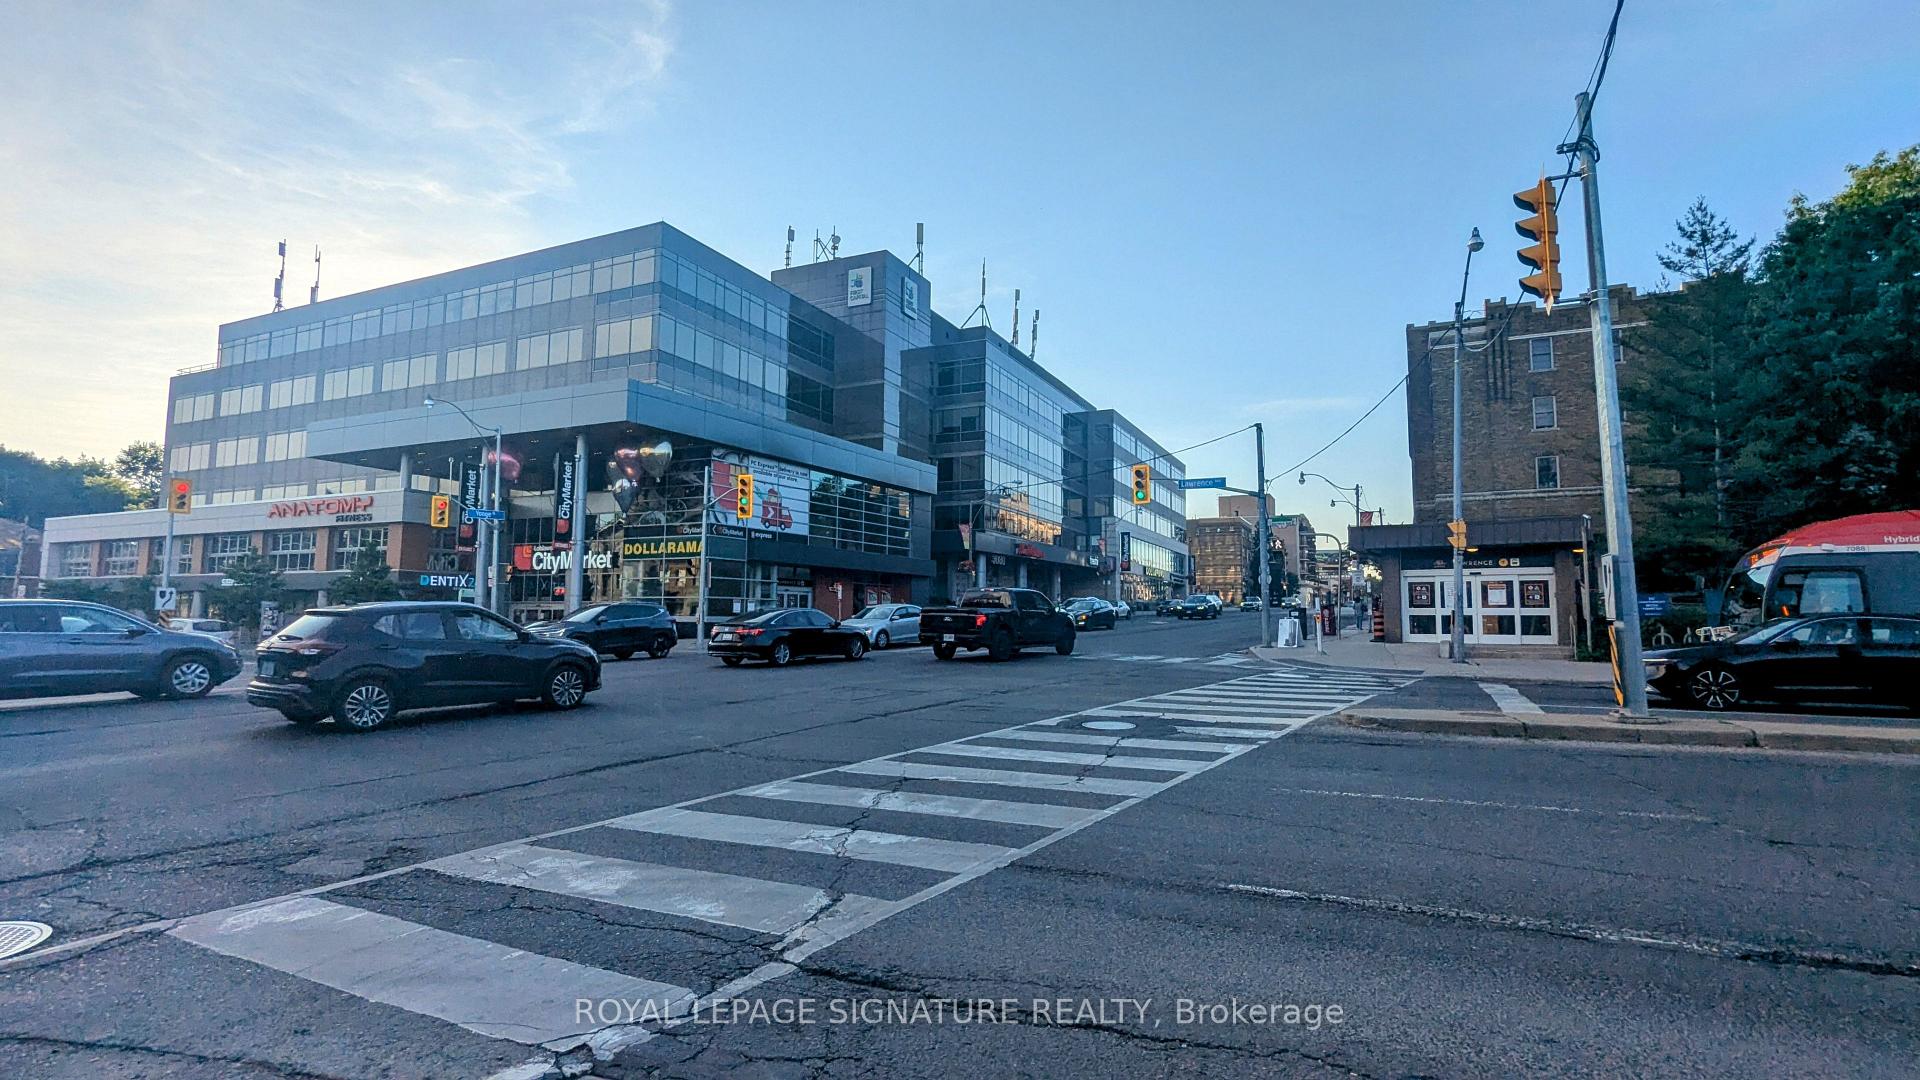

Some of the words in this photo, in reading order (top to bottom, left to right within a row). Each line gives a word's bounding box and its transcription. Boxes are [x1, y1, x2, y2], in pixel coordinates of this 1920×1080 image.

[561, 461, 573, 519] CityMarket
[1180, 480, 1214, 488] Lawrence
[266, 496, 374, 518] ANATOMY
[465, 469, 477, 525] CyMarket
[475, 510, 492, 519] Yonge
[1883, 535, 1920, 544] Hybrid
[532, 550, 612, 575] CityMrket
